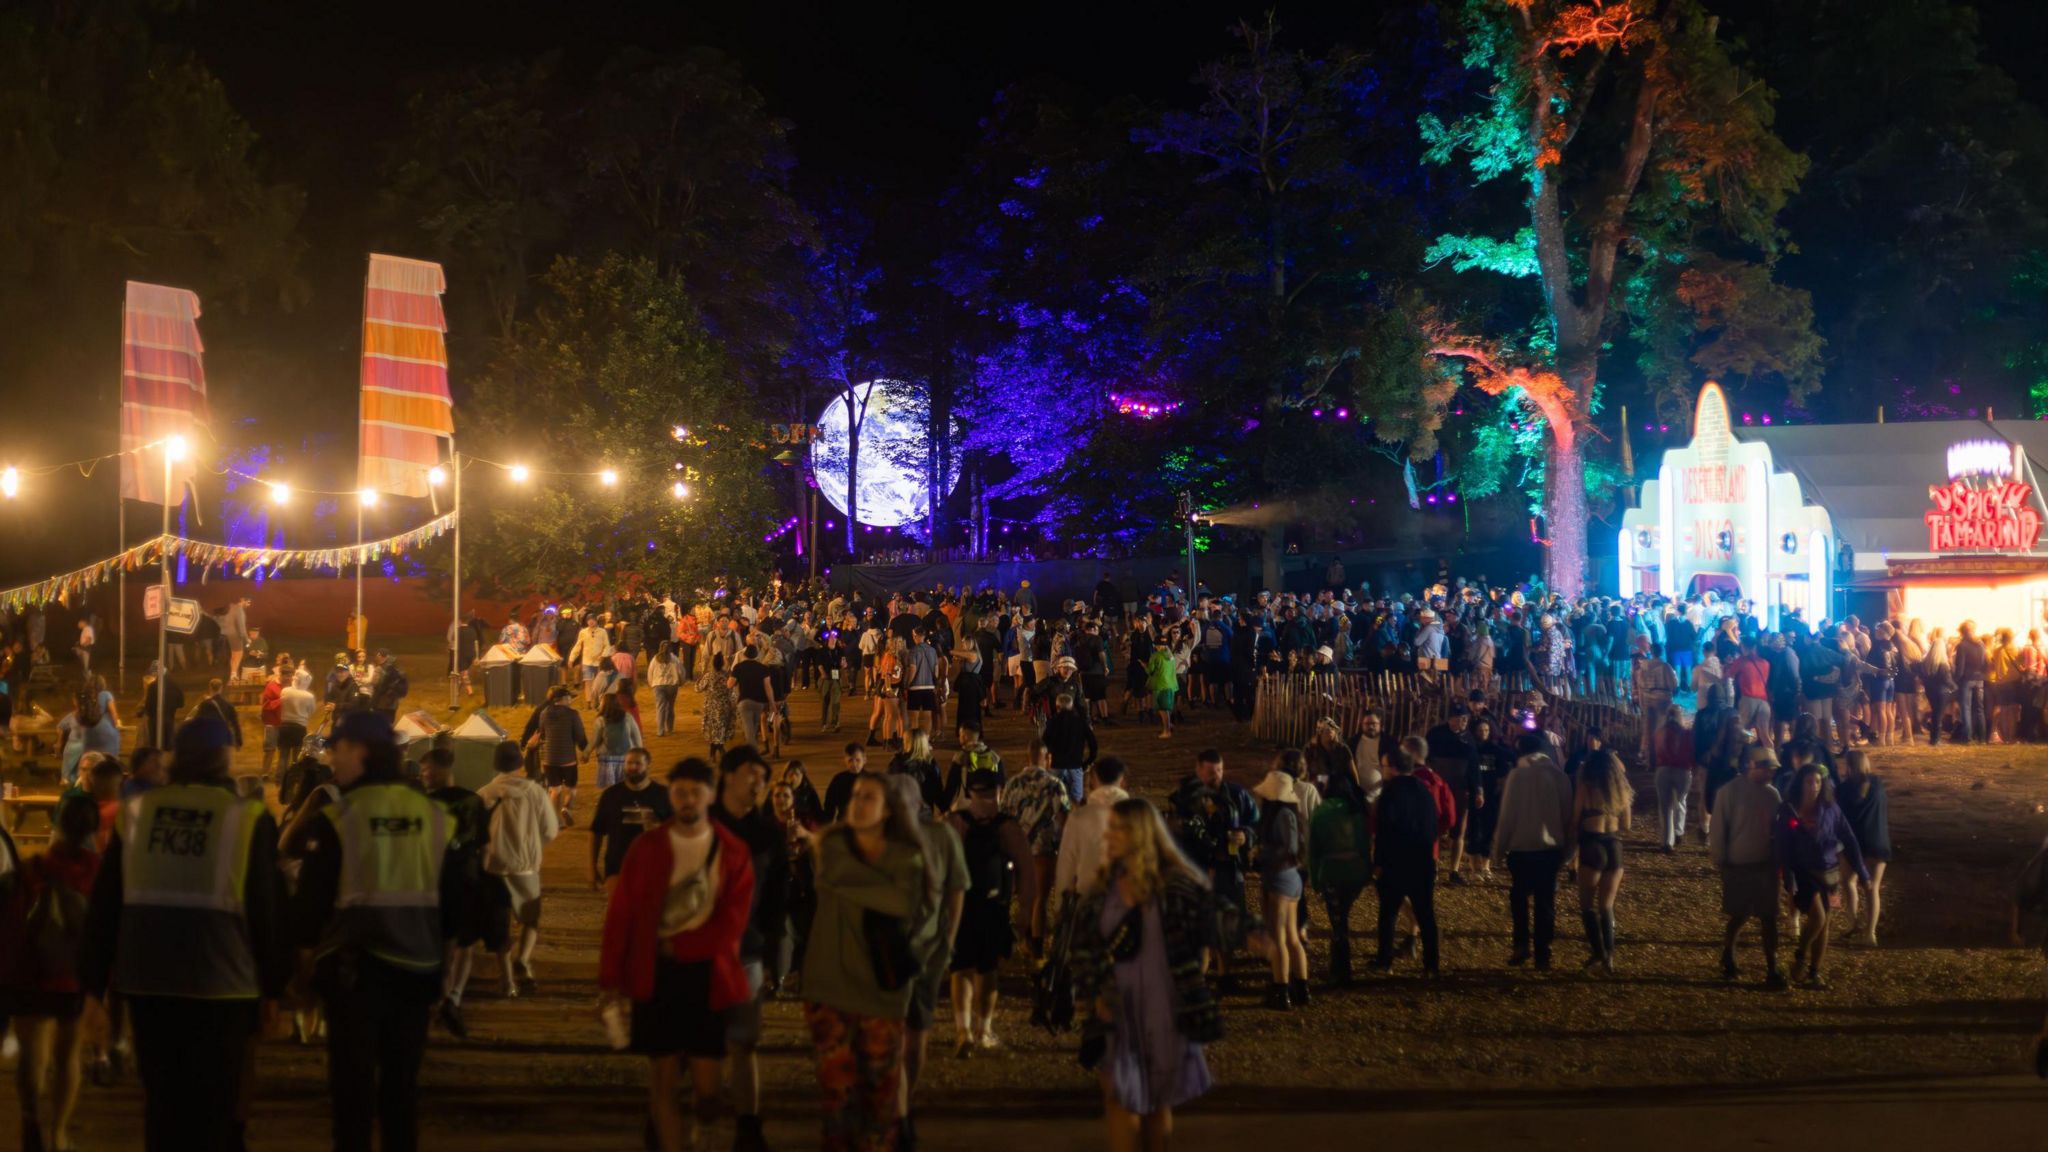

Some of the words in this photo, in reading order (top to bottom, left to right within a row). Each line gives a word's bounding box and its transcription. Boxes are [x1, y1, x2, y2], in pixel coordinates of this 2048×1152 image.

[1681, 464, 1713, 504] DESERT
[1951, 481, 2012, 522] SPICY
[1695, 518, 1735, 561] DISCO
[1925, 508, 2042, 552] TAMARIND
[147, 827, 208, 857] FK38
